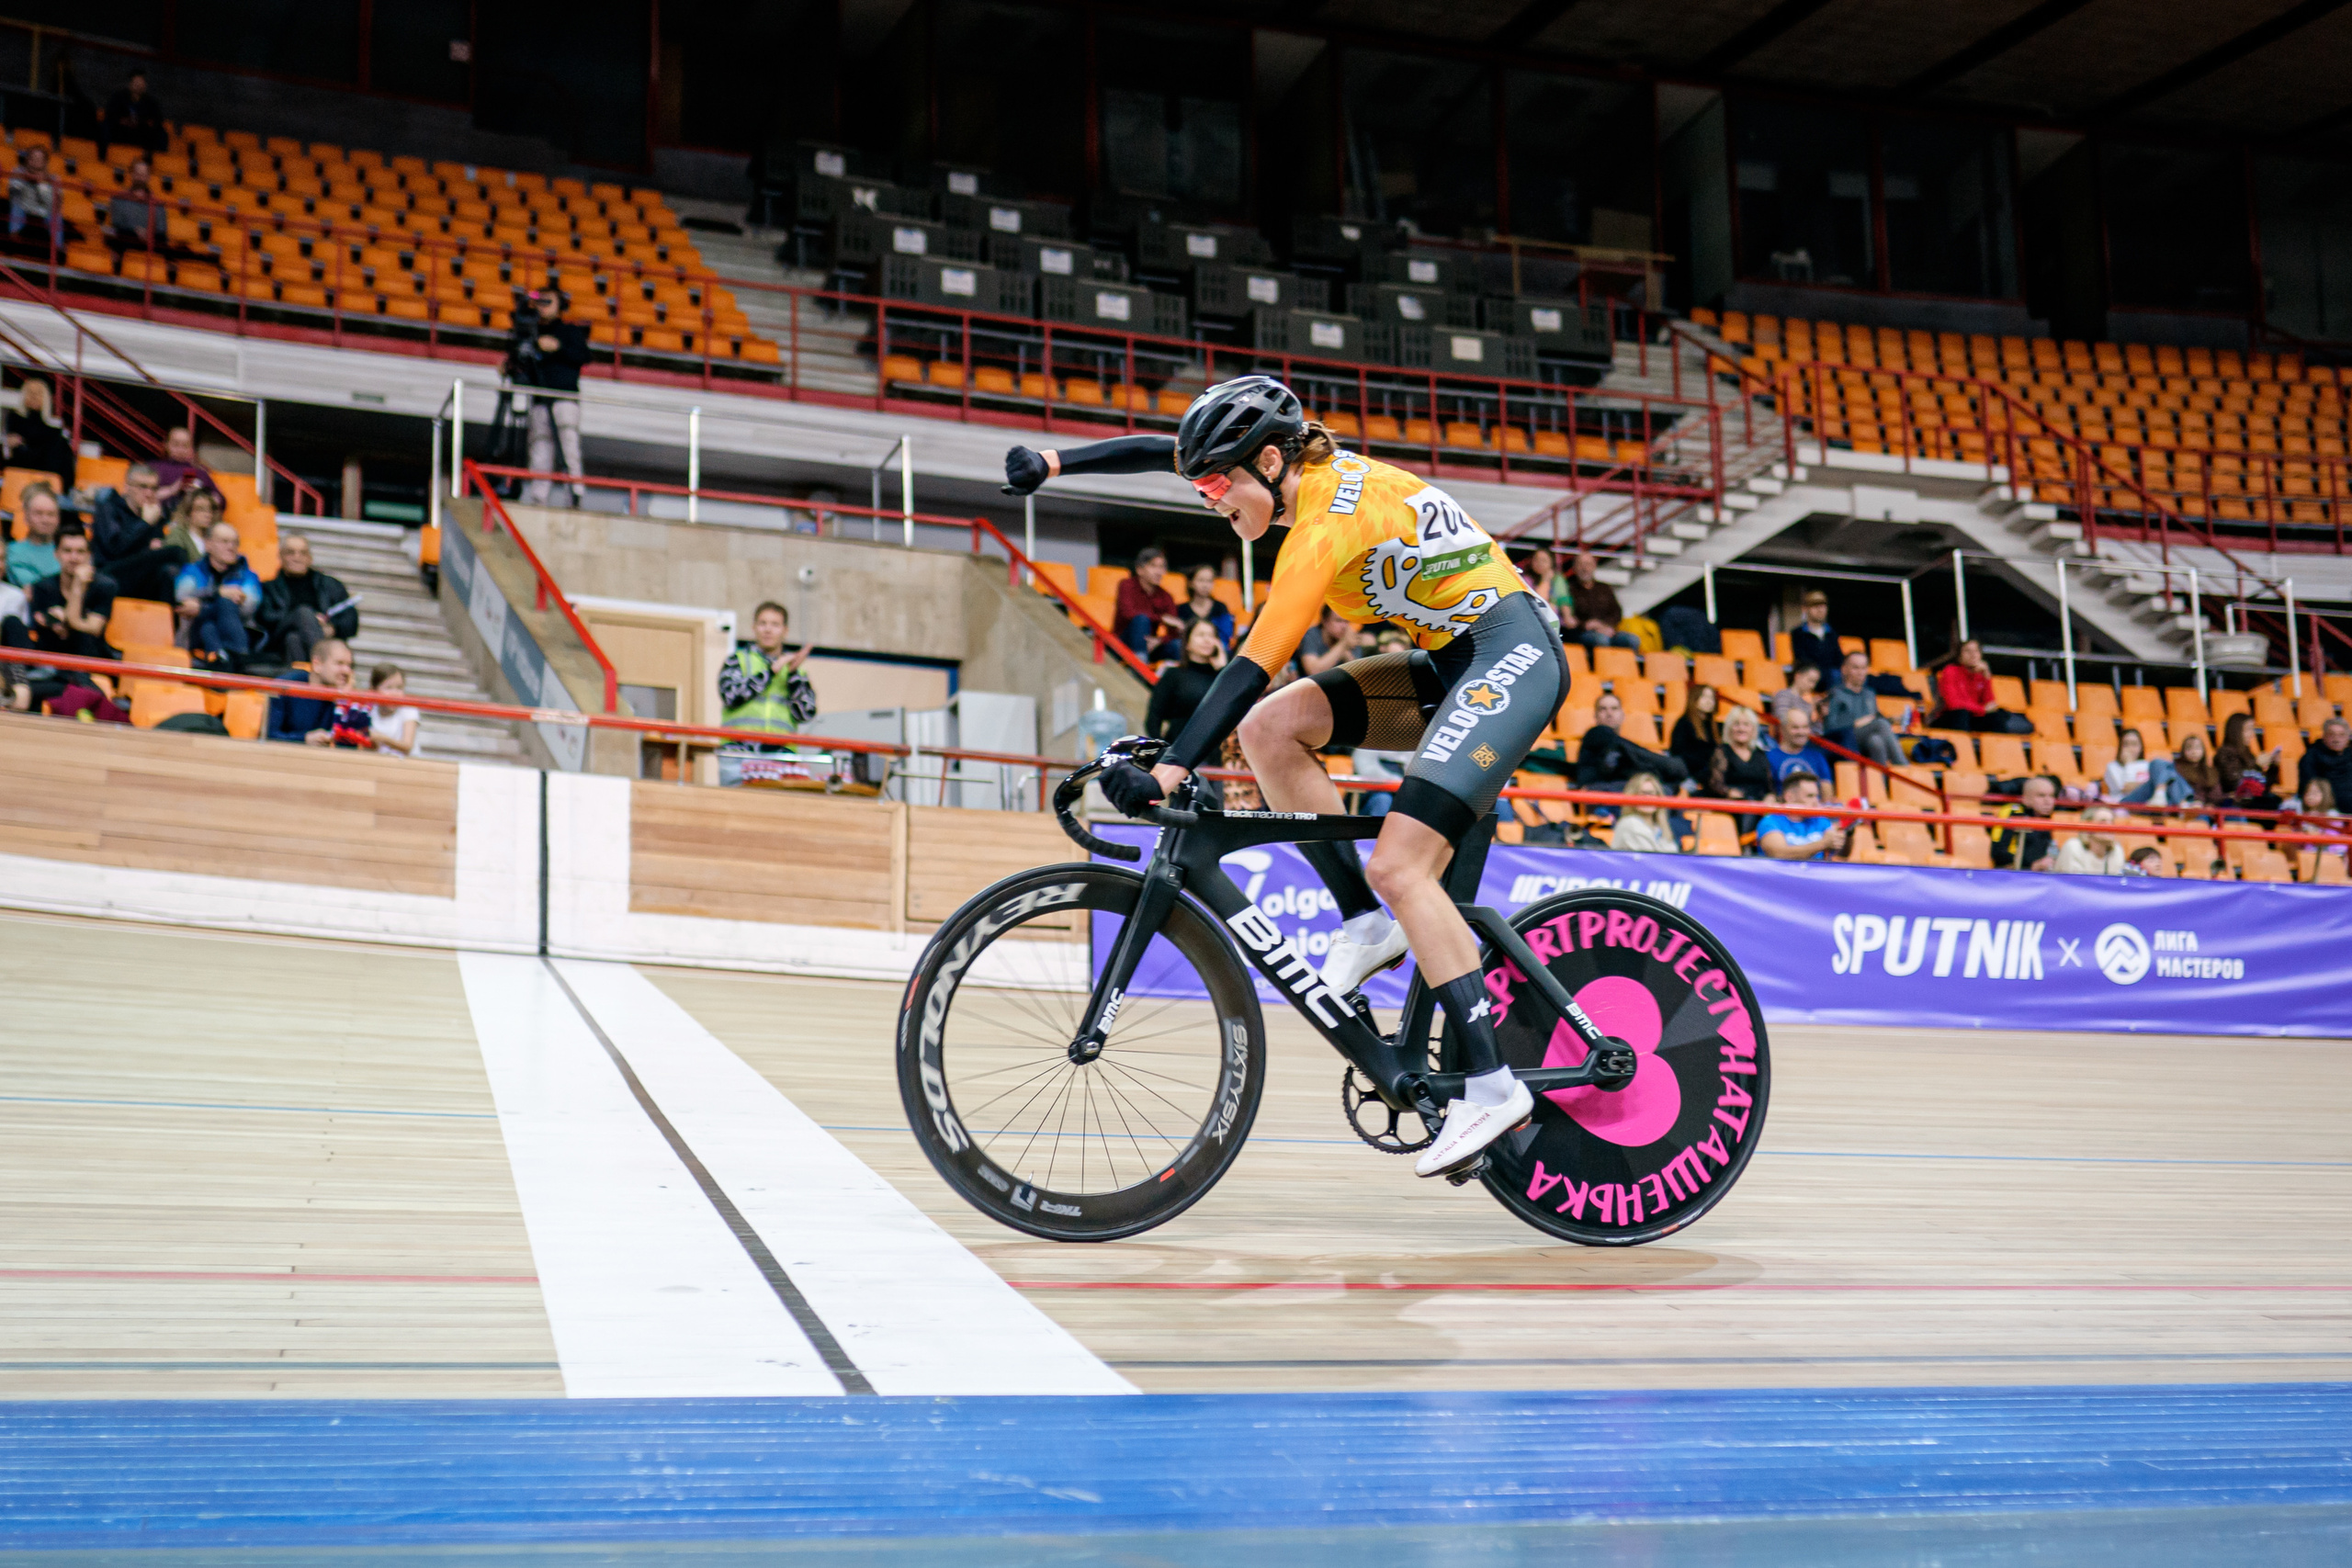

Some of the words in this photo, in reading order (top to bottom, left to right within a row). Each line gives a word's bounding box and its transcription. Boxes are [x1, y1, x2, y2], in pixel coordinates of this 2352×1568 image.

[1329, 473, 1363, 514] VELO
[1420, 709, 1480, 762] VELO
[1485, 643, 1544, 685] STAR
[1832, 912, 2047, 981] SPUTNIK
[2154, 930, 2199, 952] ЛИГА
[1226, 904, 1356, 1029] BMC
[2156, 956, 2245, 980] МАСТЕРОВ
[919, 883, 1089, 1155] REYNOLDS
[1096, 987, 1125, 1034] BMC
[1565, 1002, 1603, 1040] BMC
